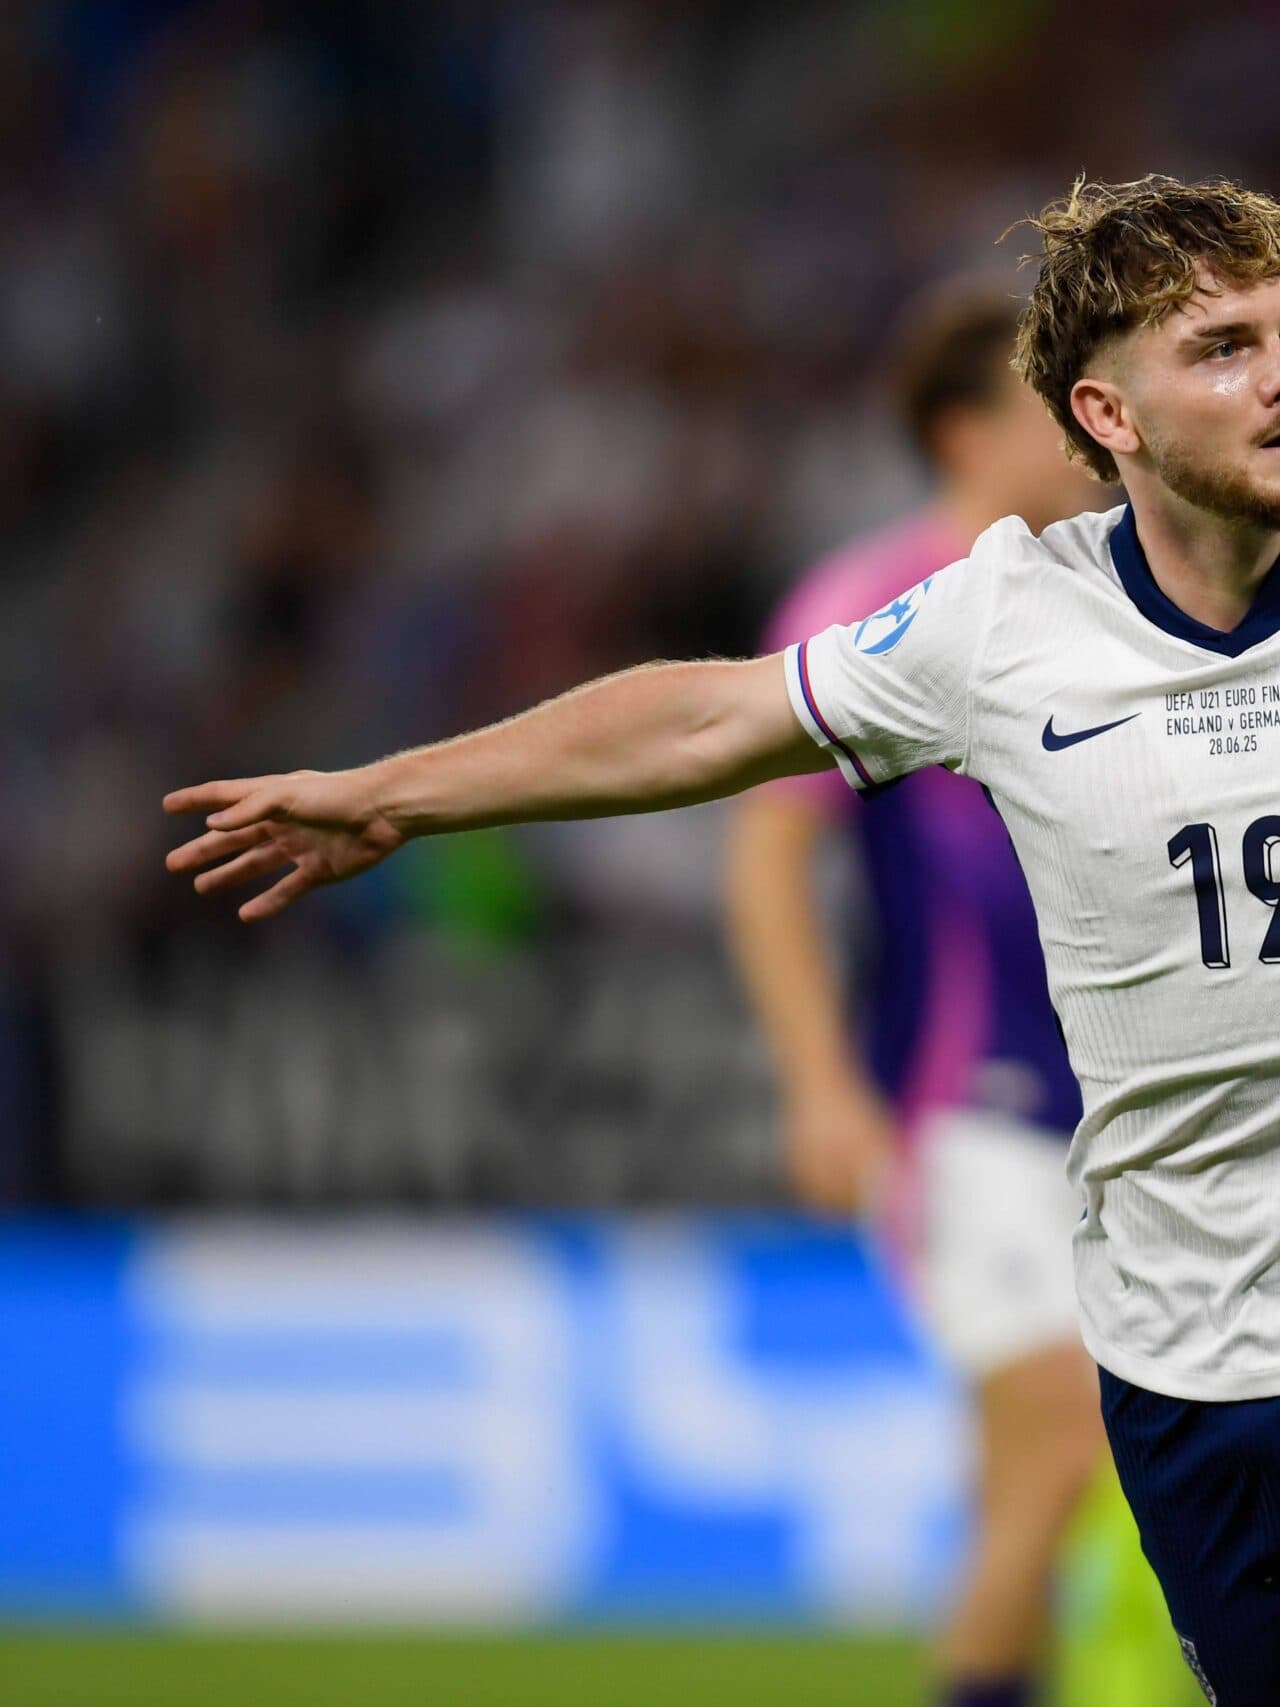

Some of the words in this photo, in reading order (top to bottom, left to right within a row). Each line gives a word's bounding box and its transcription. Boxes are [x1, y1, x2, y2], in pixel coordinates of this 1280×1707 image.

[1165, 692, 1195, 712] UEFA
[1200, 690, 1221, 710] U21
[1225, 687, 1256, 708] EURO
[1166, 715, 1223, 736] ENGLAND
[1227, 718, 1234, 731] v
[1209, 734, 1258, 756] 28.06.25
